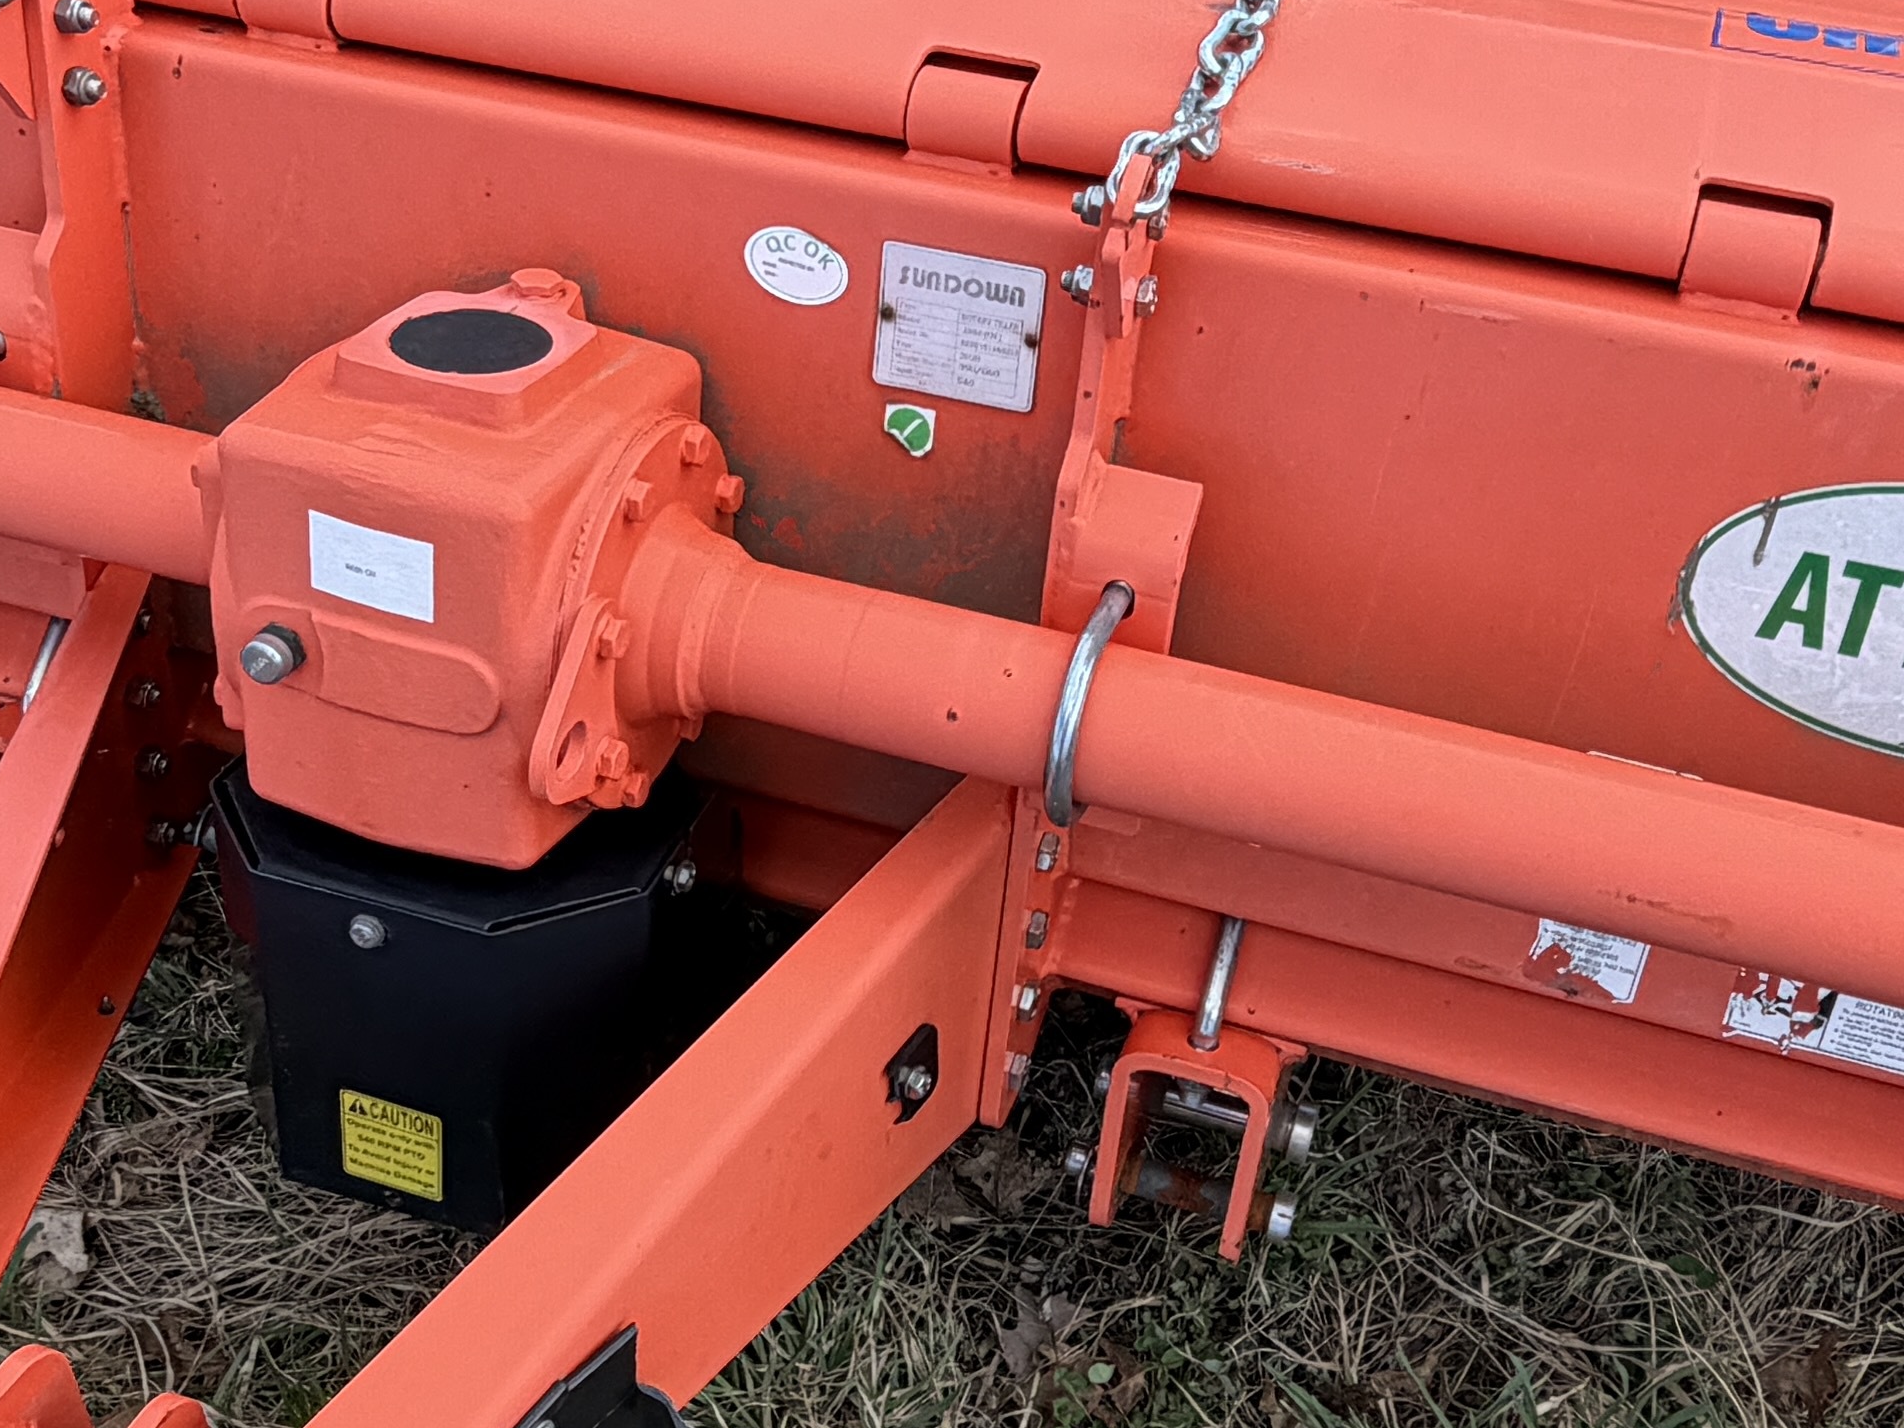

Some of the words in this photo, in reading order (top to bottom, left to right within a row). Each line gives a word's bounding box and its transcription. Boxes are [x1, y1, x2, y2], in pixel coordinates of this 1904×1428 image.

[765, 234, 797, 254] QC
[804, 241, 835, 271] OK
[898, 265, 1026, 308] SUNDOWN
[369, 1102, 434, 1137] CAUTION
